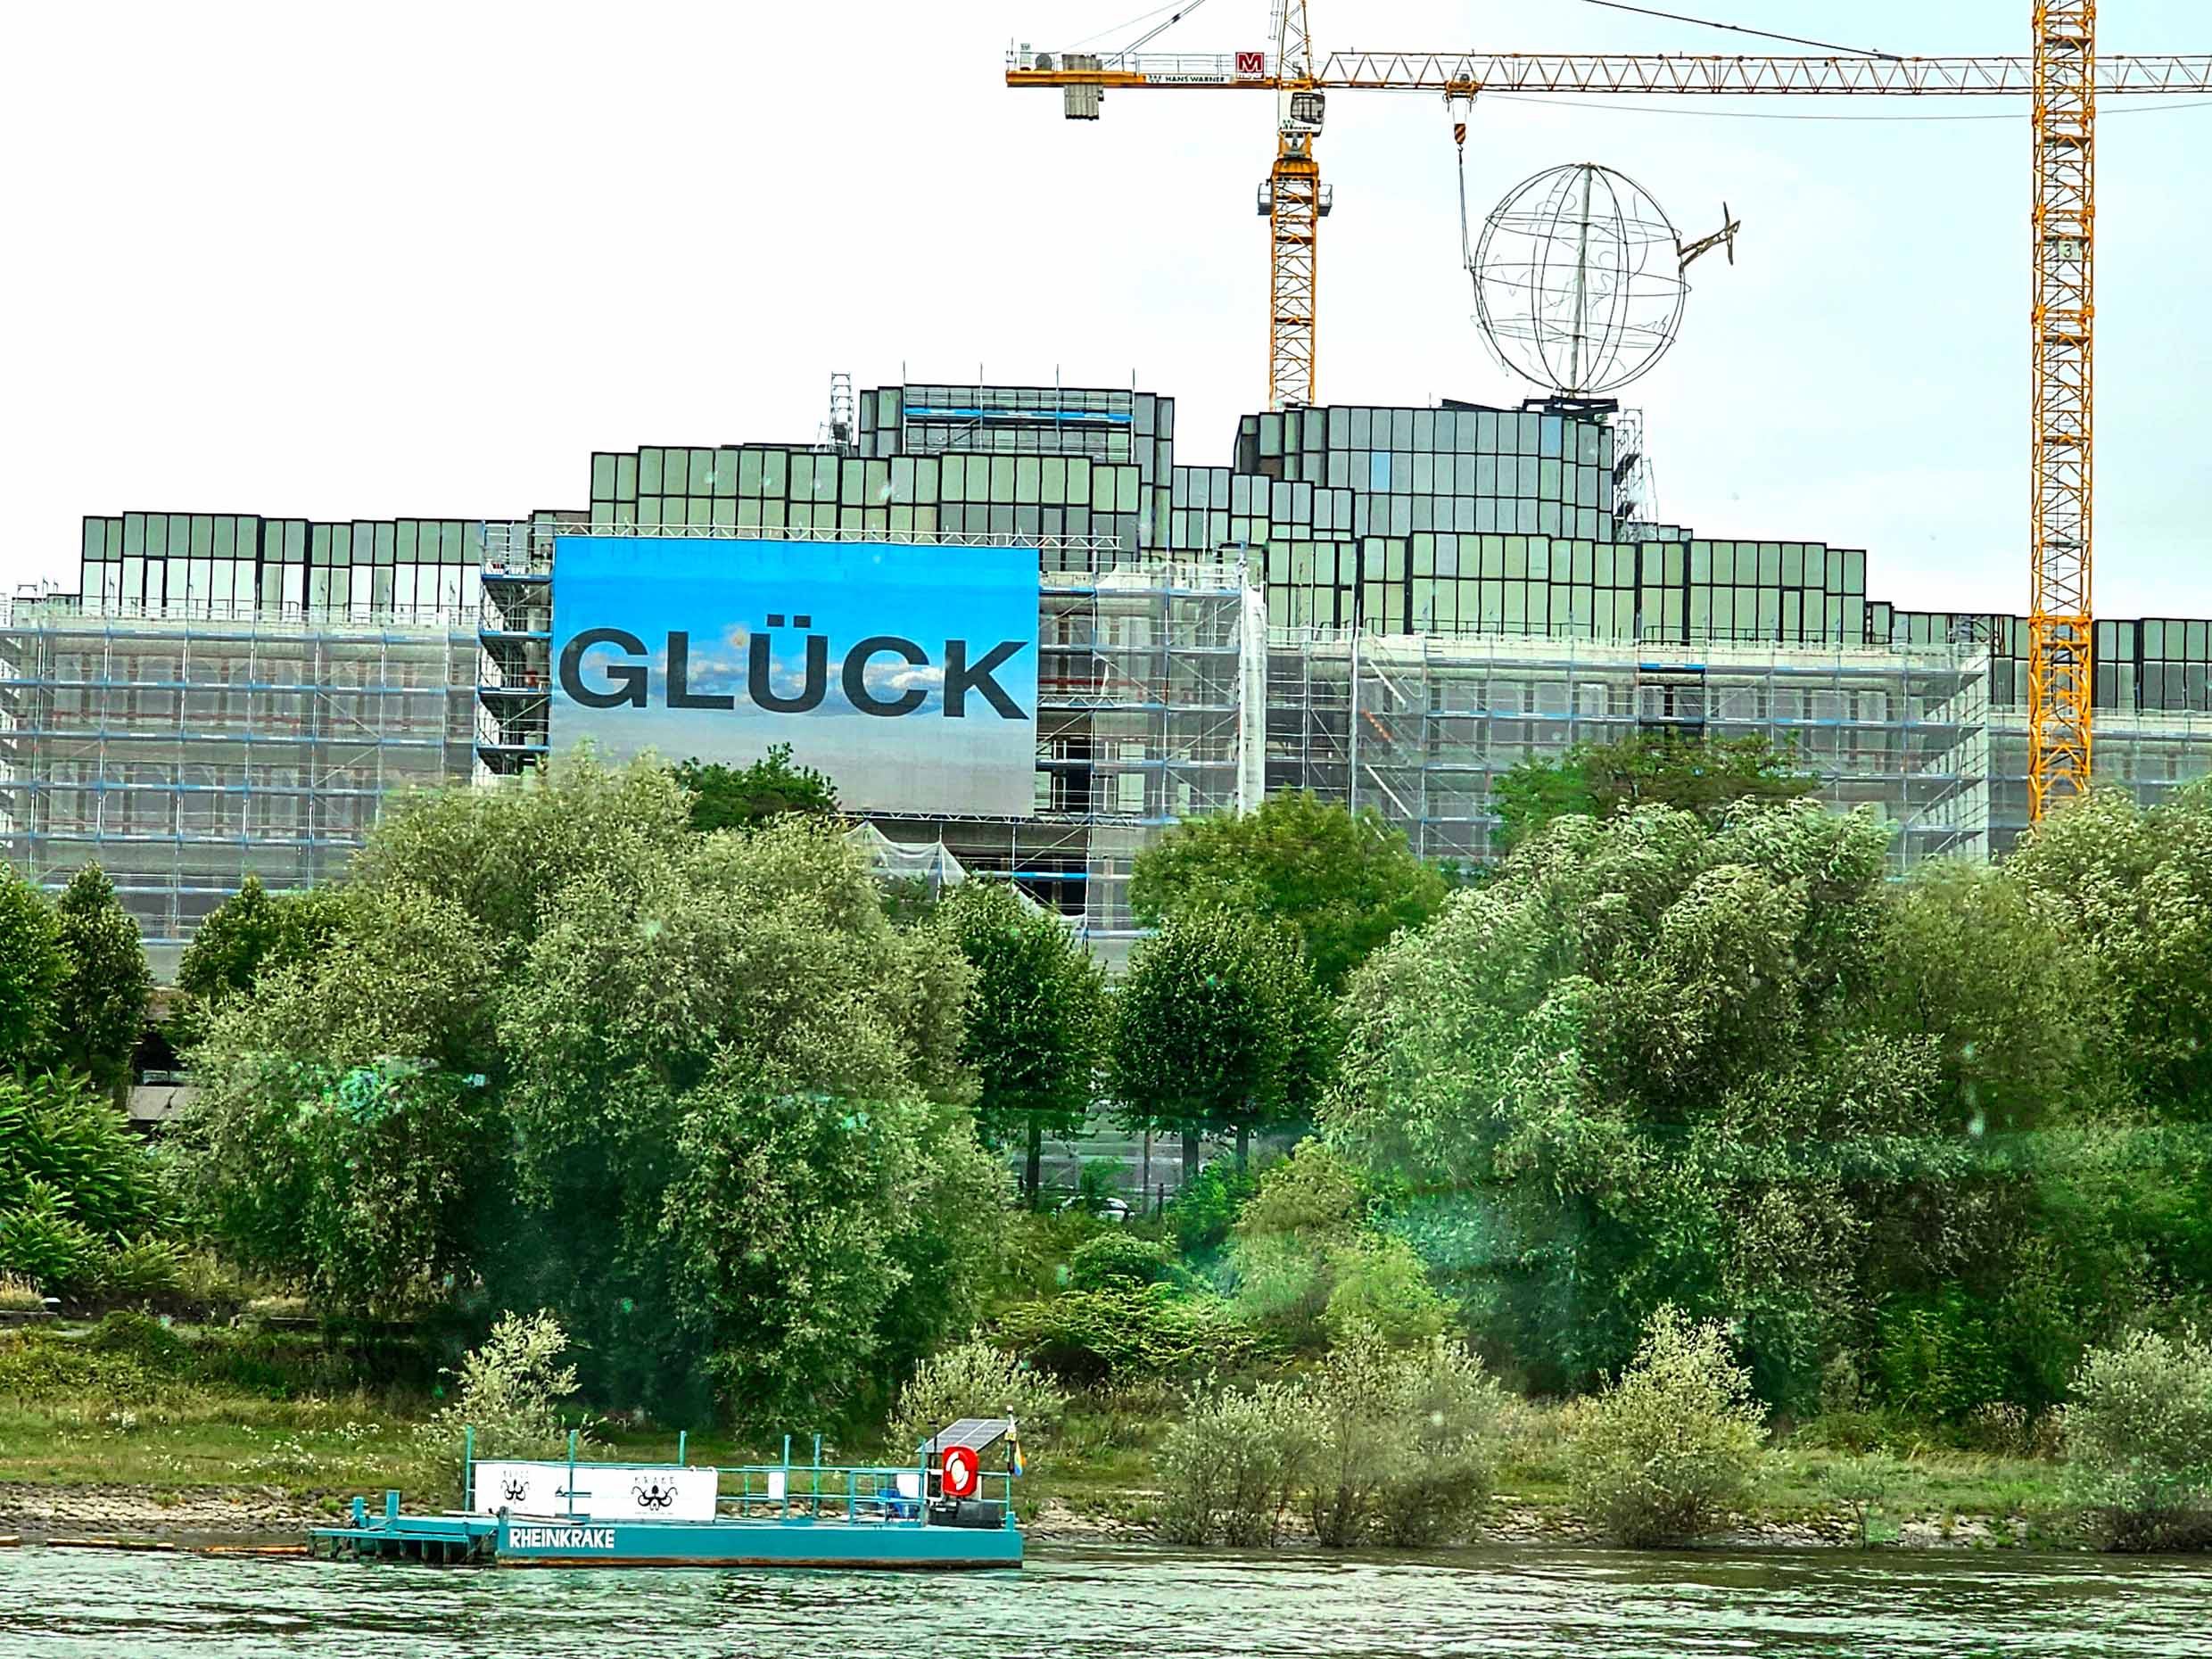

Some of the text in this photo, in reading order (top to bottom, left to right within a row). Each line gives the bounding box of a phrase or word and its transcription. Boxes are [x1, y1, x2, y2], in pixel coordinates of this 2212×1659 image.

[2063, 243, 2073, 258] 3
[558, 614, 1030, 720] GLÜCK
[509, 1528, 615, 1548] RHEINKRAKE
